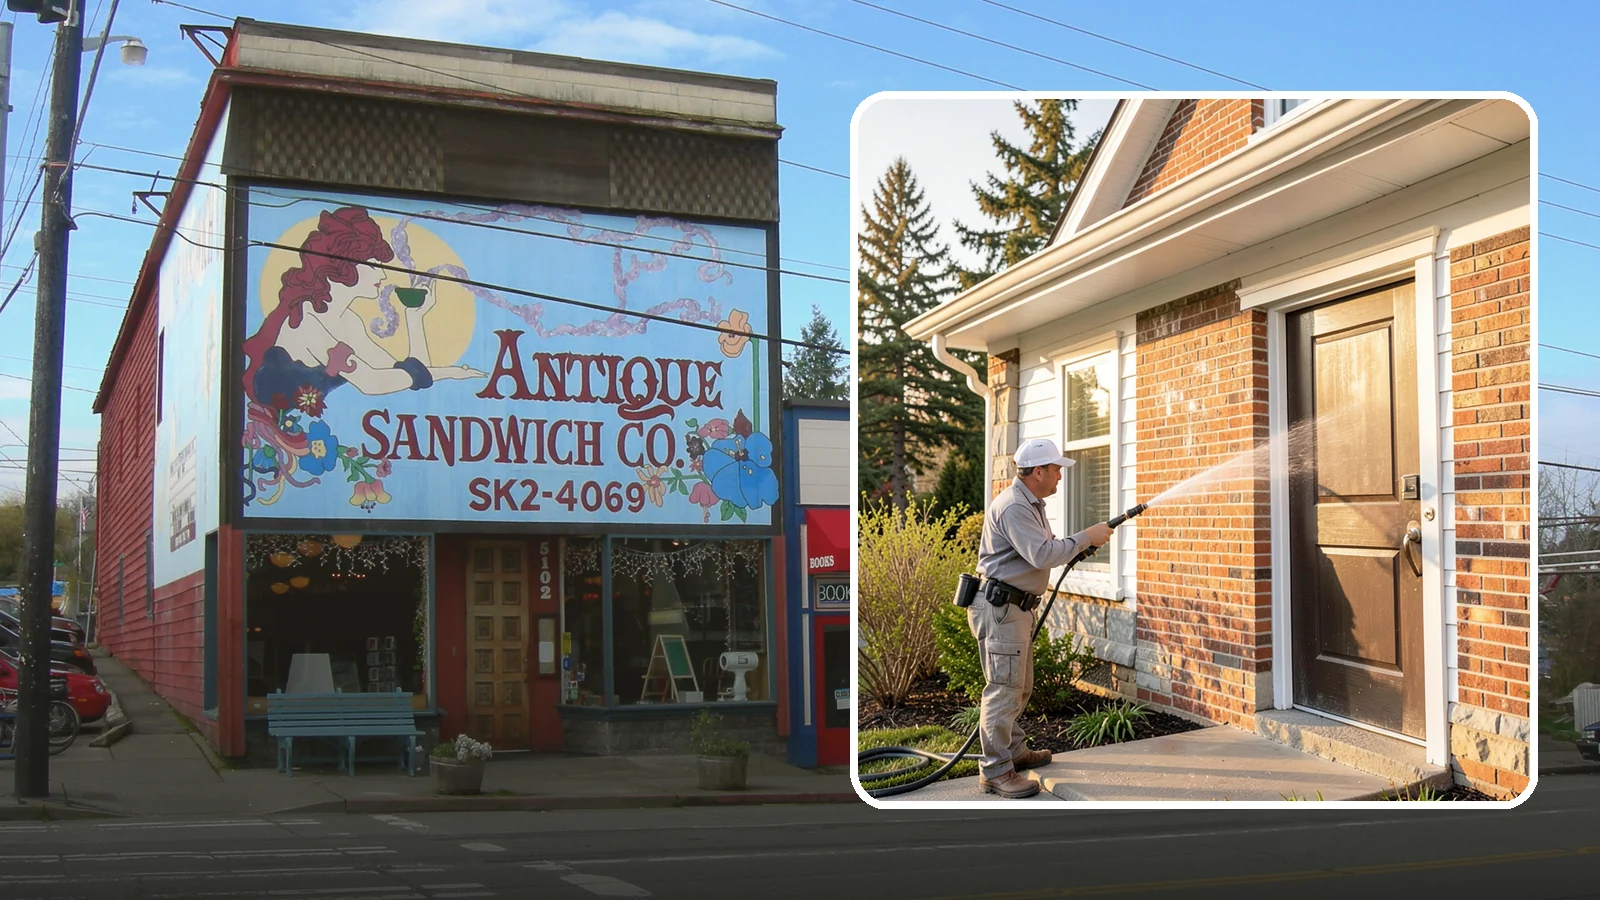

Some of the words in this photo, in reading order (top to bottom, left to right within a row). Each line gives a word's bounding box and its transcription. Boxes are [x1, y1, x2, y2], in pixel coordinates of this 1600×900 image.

[475, 328, 724, 421] ANTIQUE
[361, 408, 604, 467] SANDWICH
[617, 423, 686, 469] CO.
[468, 477, 646, 512] SK2-4069
[539, 542, 552, 600] 5102
[809, 555, 835, 569] BOOKS
